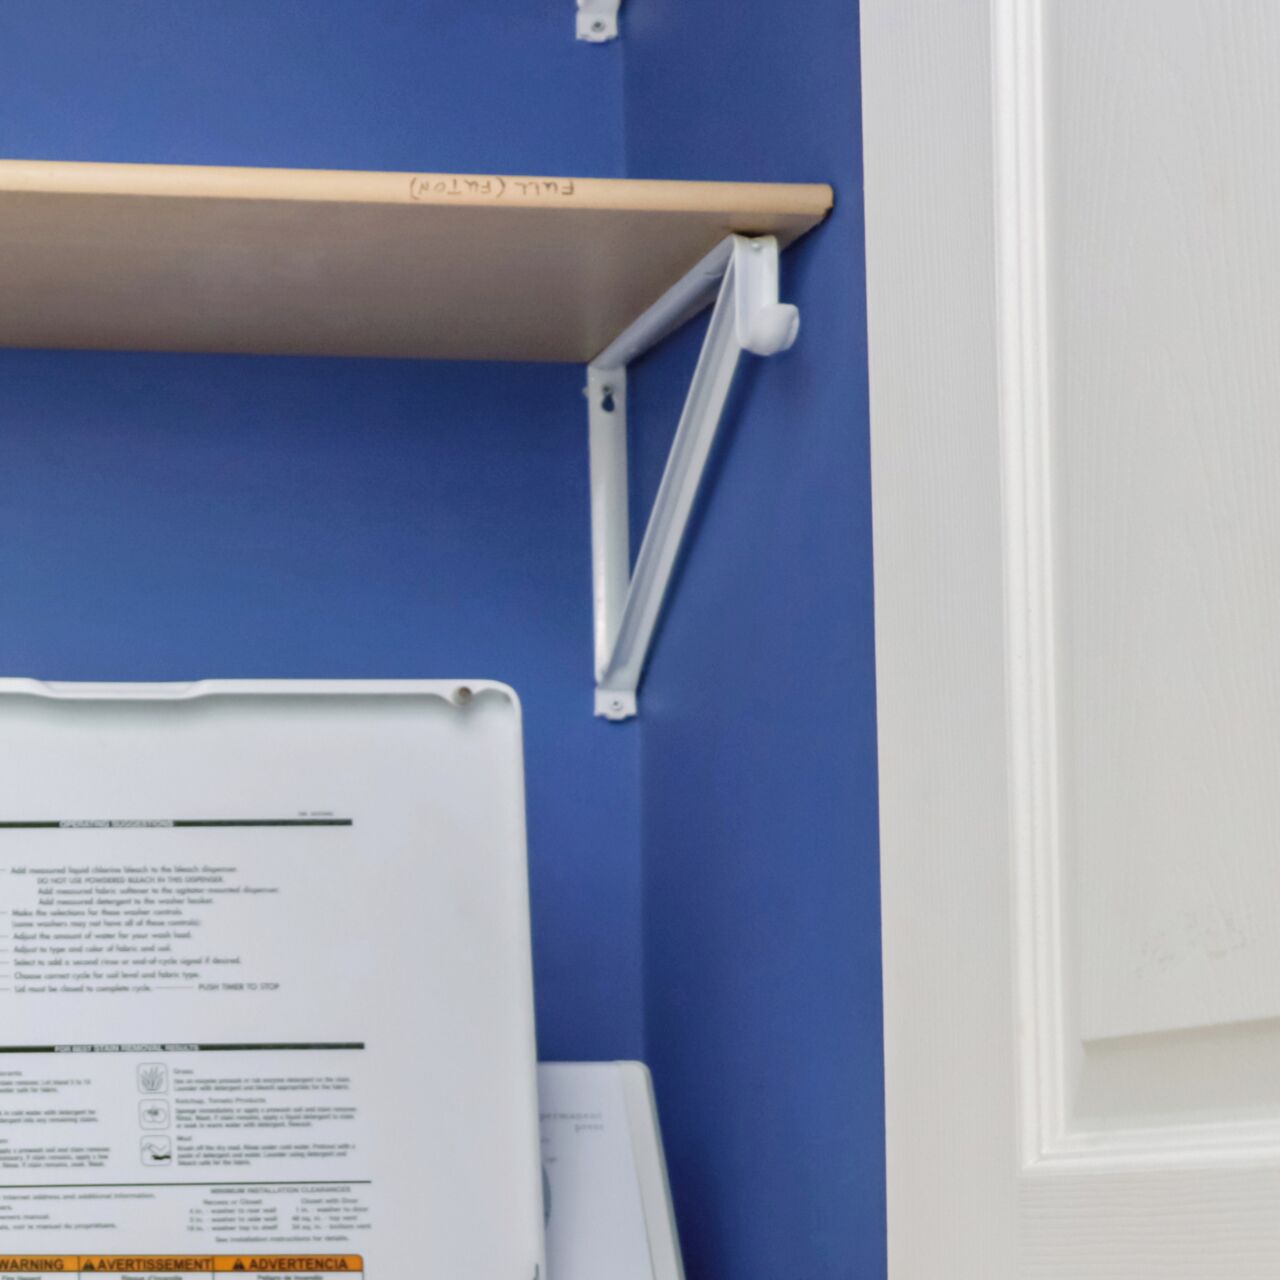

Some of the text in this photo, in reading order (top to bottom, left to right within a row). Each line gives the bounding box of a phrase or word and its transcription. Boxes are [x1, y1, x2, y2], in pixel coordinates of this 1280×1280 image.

[514, 180, 575, 197] FULL
[98, 1258, 212, 1270] AVERTISSEMENT
[249, 1258, 349, 1270] ADVERTENCIA
